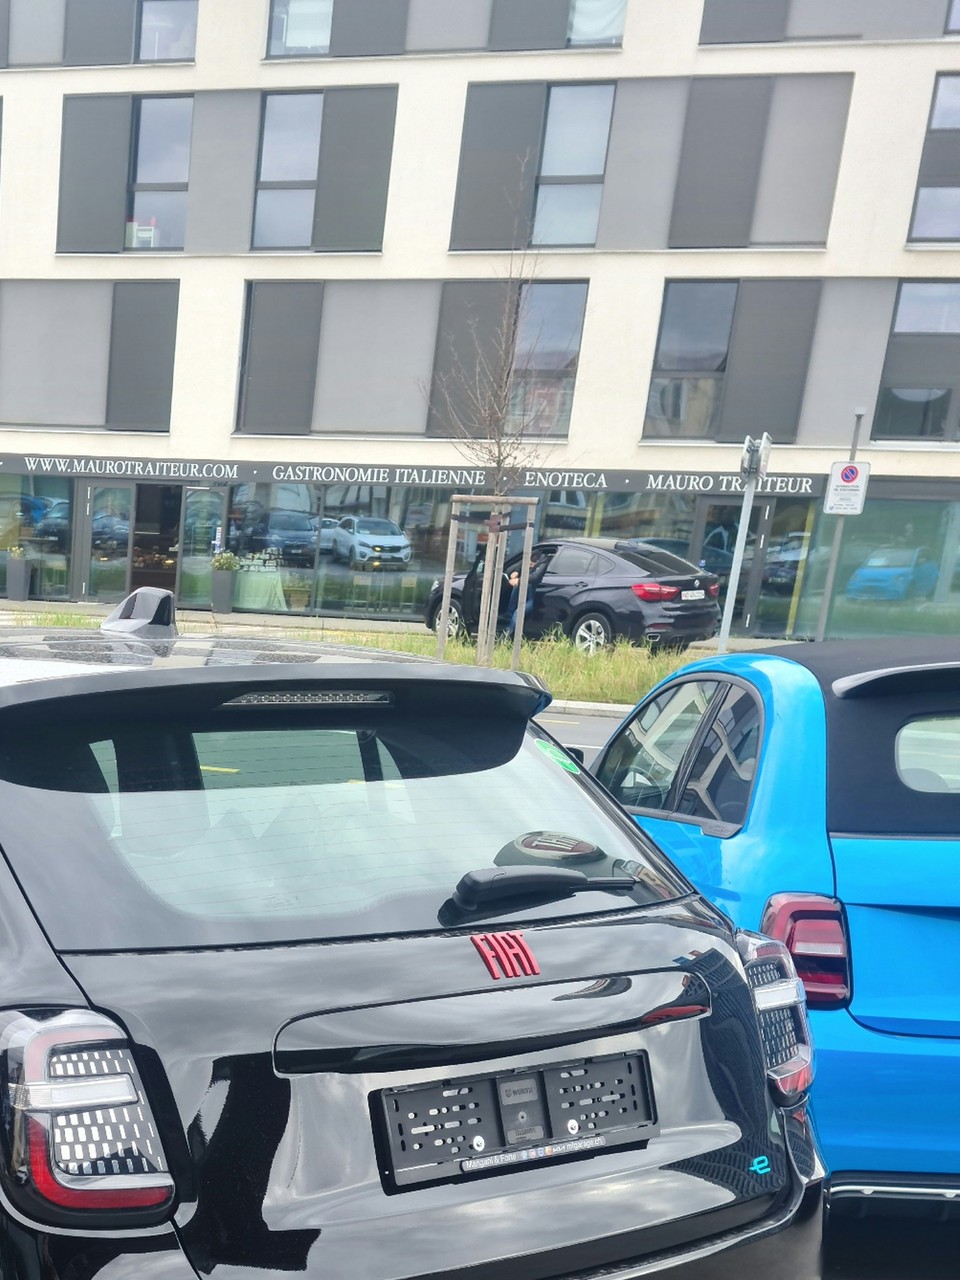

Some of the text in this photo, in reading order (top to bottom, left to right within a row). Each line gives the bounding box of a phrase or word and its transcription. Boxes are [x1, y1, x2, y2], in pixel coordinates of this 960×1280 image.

[24, 457, 239, 479] WWW.MAUROTRAITEUR.COM
[272, 465, 486, 486] GASTRONOMIE ITALIENNE
[523, 471, 608, 488] ENOTECA
[646, 474, 714, 491] MAURO
[469, 929, 541, 981] FIAT
